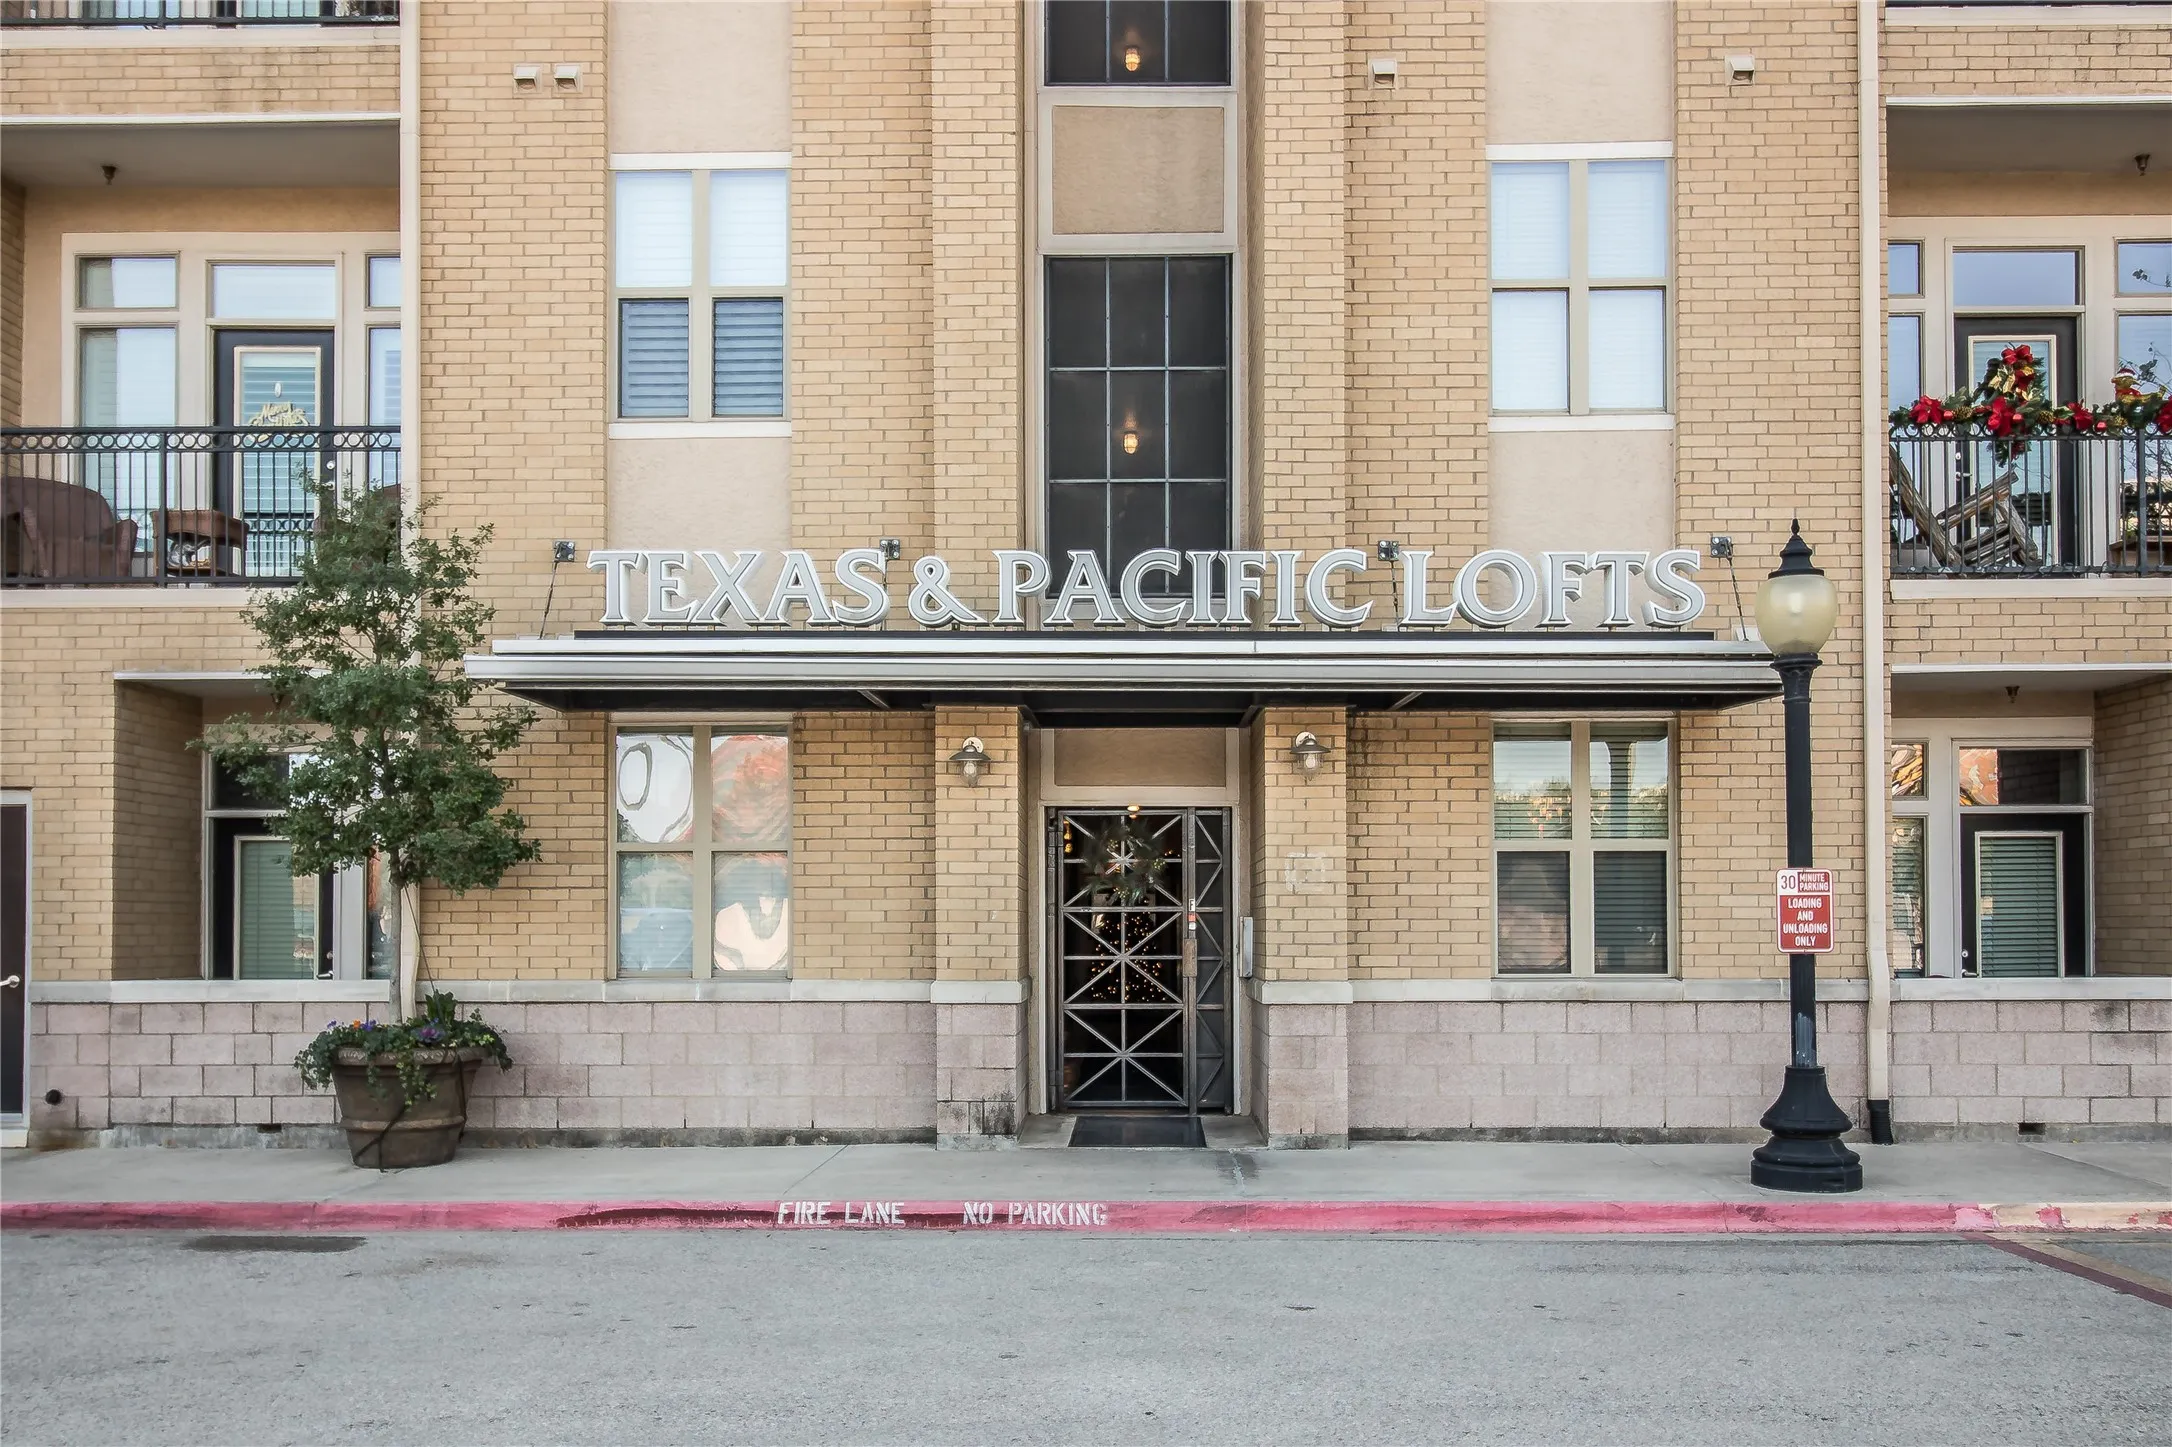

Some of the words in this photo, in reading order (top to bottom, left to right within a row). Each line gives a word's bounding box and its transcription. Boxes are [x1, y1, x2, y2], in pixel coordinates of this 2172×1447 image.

[587, 548, 890, 627] TEXAS
[908, 555, 988, 628] &
[992, 548, 1374, 629] PACIFIC
[1400, 548, 1706, 629] LOFTS
[1780, 875, 1796, 890] 30
[1799, 873, 1825, 882] MINUTE
[1799, 882, 1829, 891] PARKING
[1787, 898, 1822, 909] LOADING
[1796, 910, 1814, 921] AND
[1782, 923, 1828, 934] UNLOADING
[1794, 935, 1816, 947] ONLY
[777, 1201, 832, 1225] FIRE
[844, 1201, 905, 1224] LANE
[962, 1201, 993, 1225] NO
[1007, 1201, 1108, 1226] PARKING
